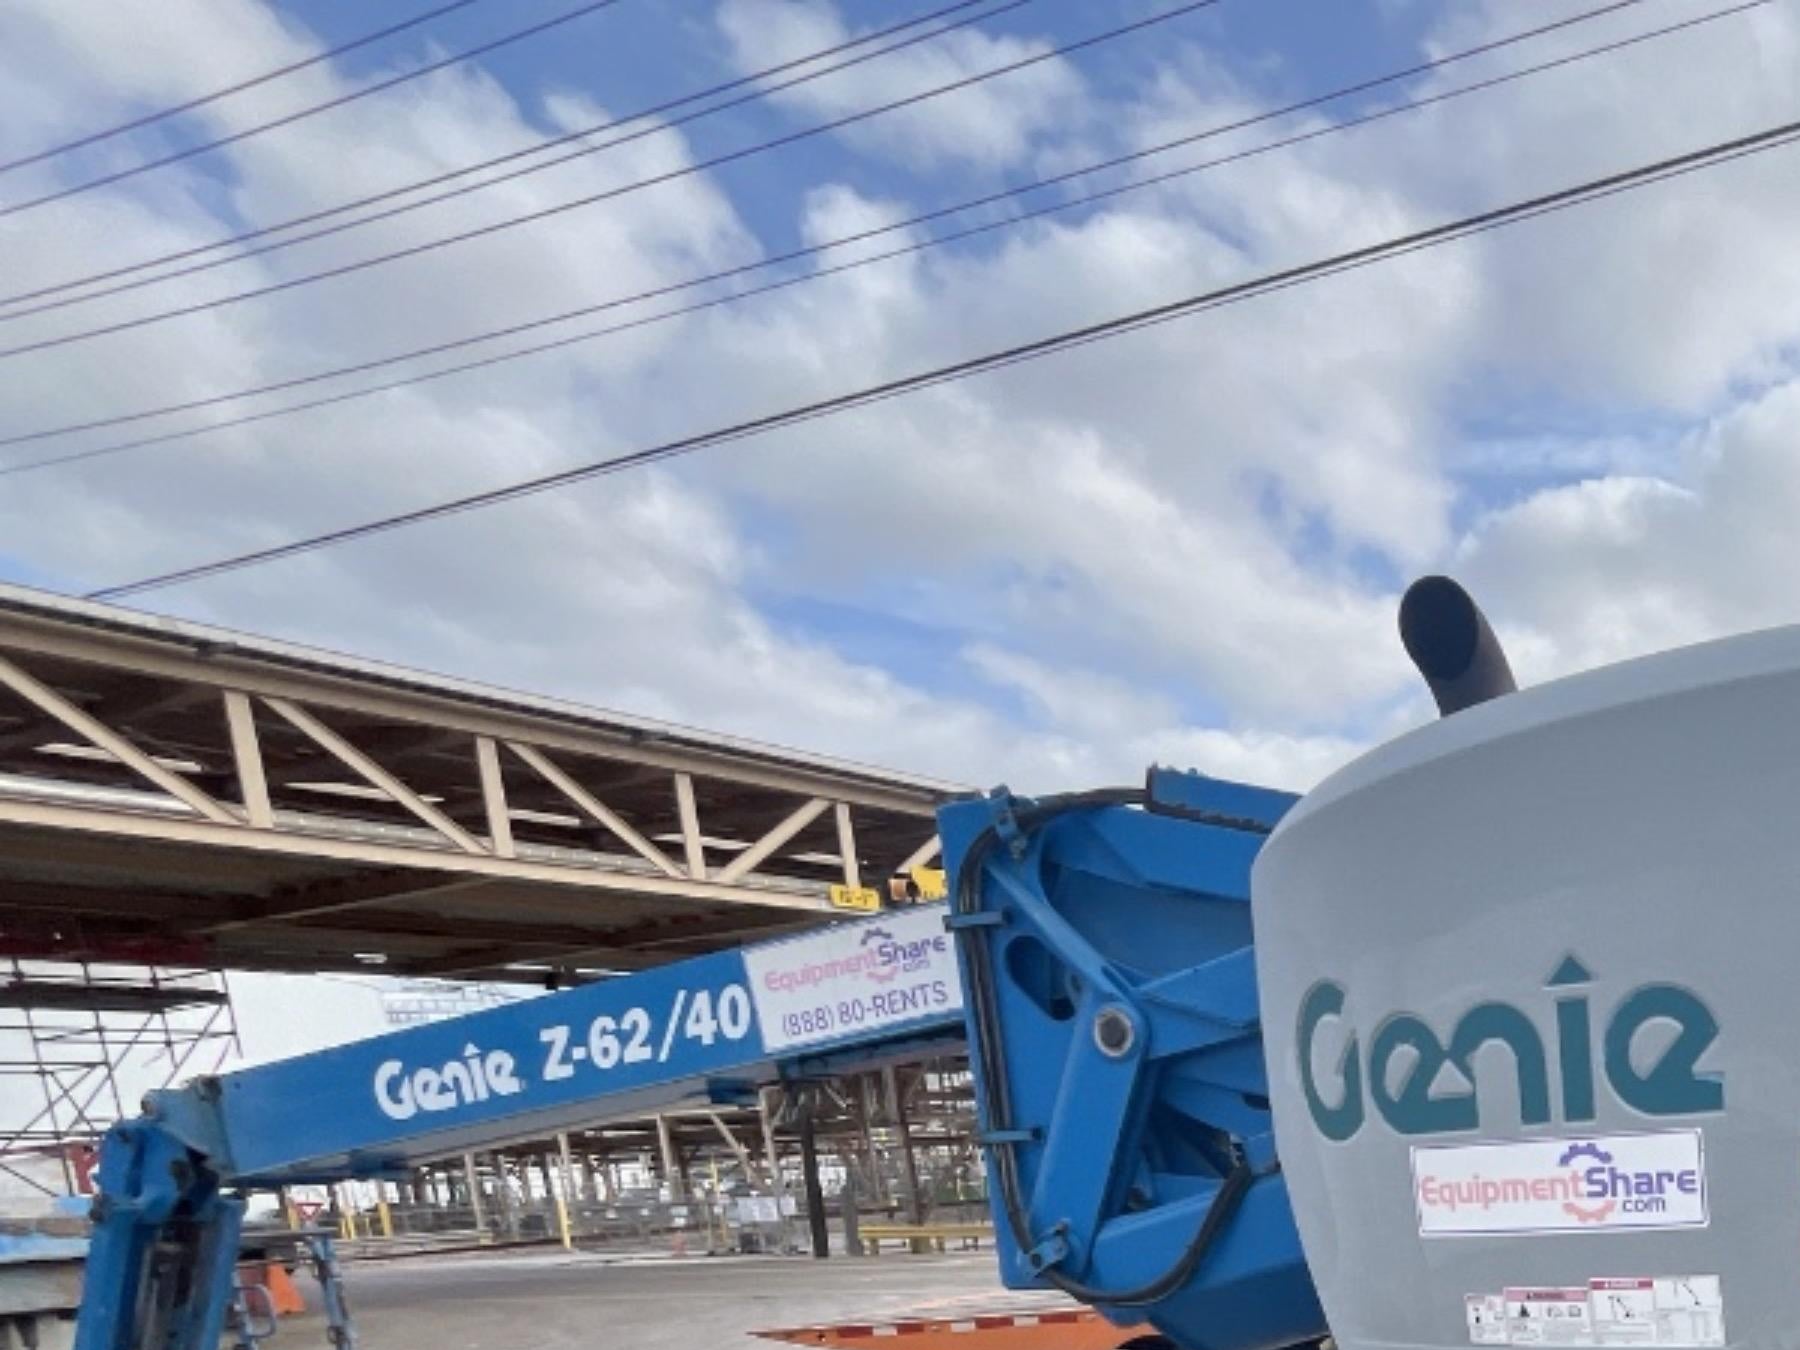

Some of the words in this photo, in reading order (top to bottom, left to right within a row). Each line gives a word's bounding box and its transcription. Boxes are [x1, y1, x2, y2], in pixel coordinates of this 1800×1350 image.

[838, 980, 949, 1027] 80-RENTS
[1297, 951, 1726, 1142] Genie
[374, 1041, 523, 1121] Genie
[539, 983, 752, 1083] Z-62/40
[1420, 1165, 1698, 1212] EquipmentShare
